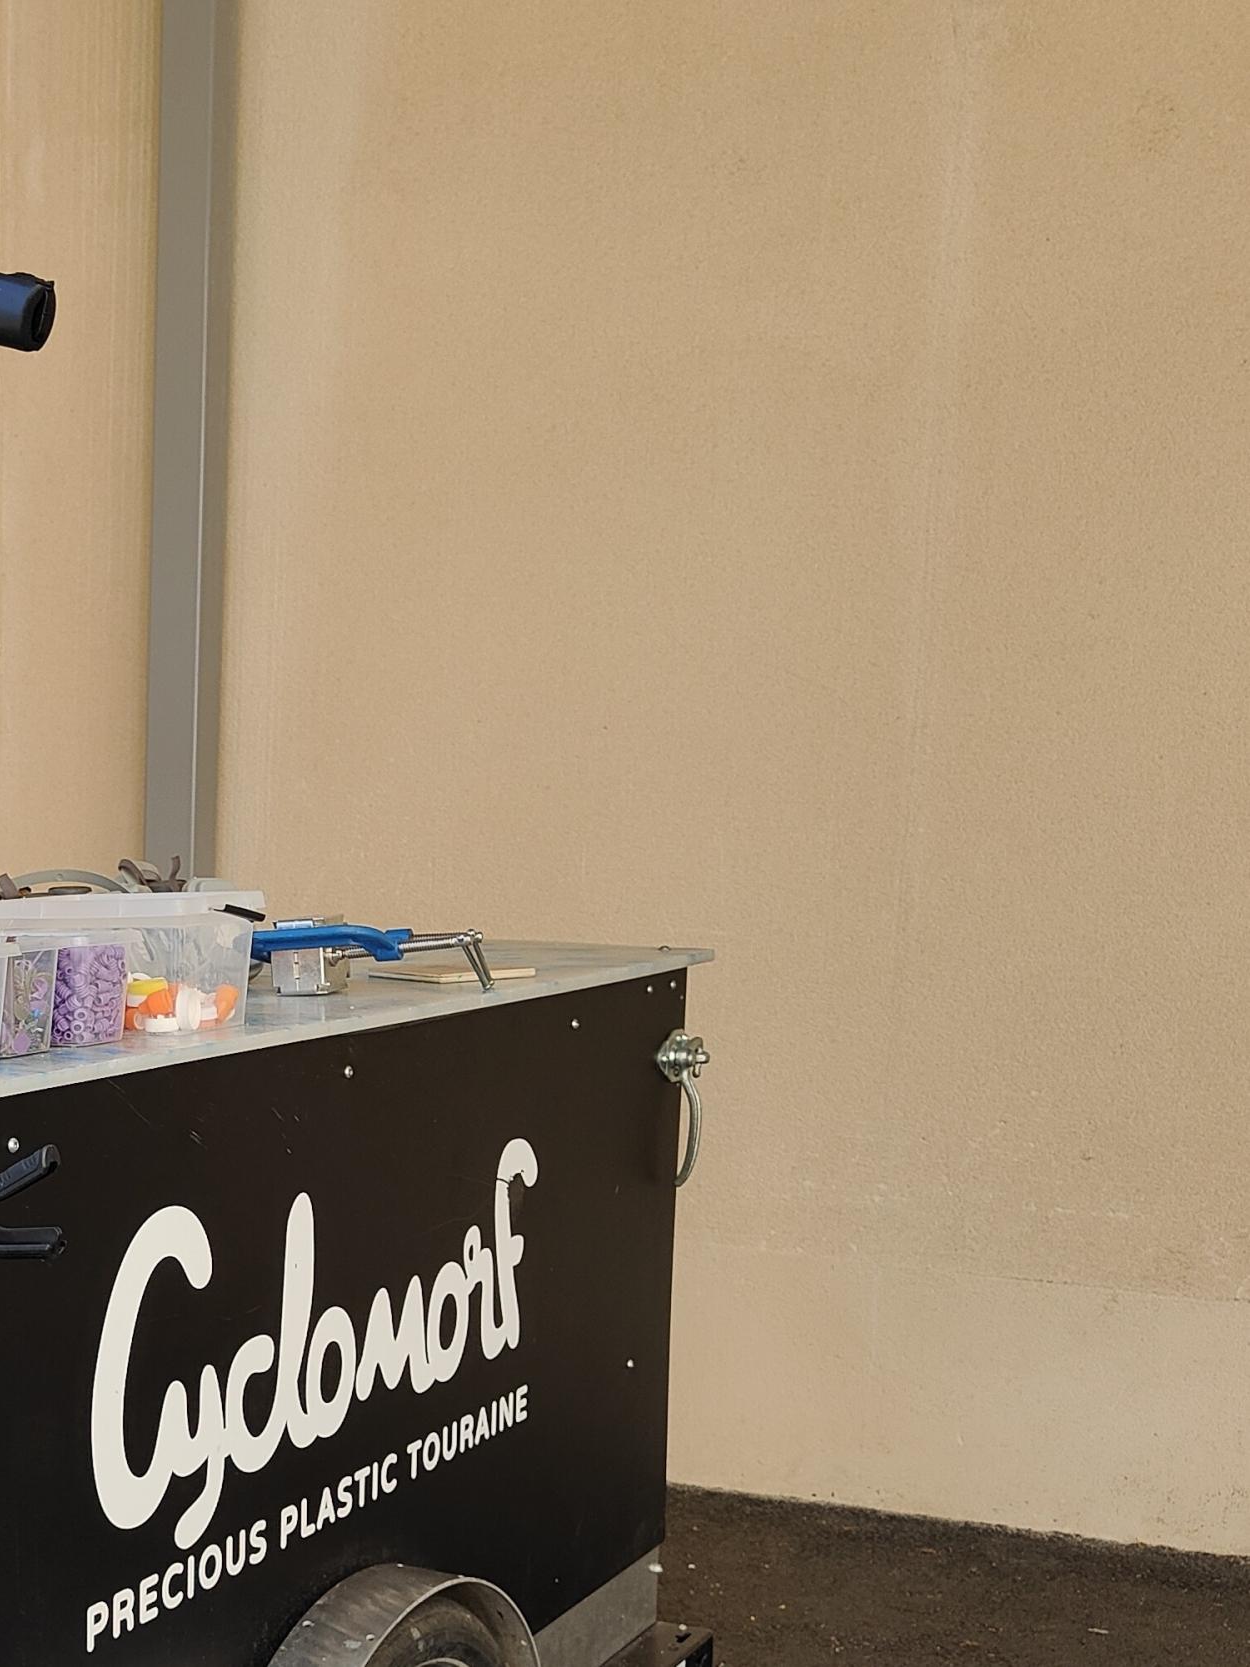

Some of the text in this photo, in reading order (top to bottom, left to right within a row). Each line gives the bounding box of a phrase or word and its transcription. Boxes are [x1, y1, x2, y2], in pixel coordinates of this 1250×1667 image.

[90, 1137, 539, 1550] Cyclomorf
[86, 1384, 529, 1653] PRECIOUS PLASTIC TOURAINE
